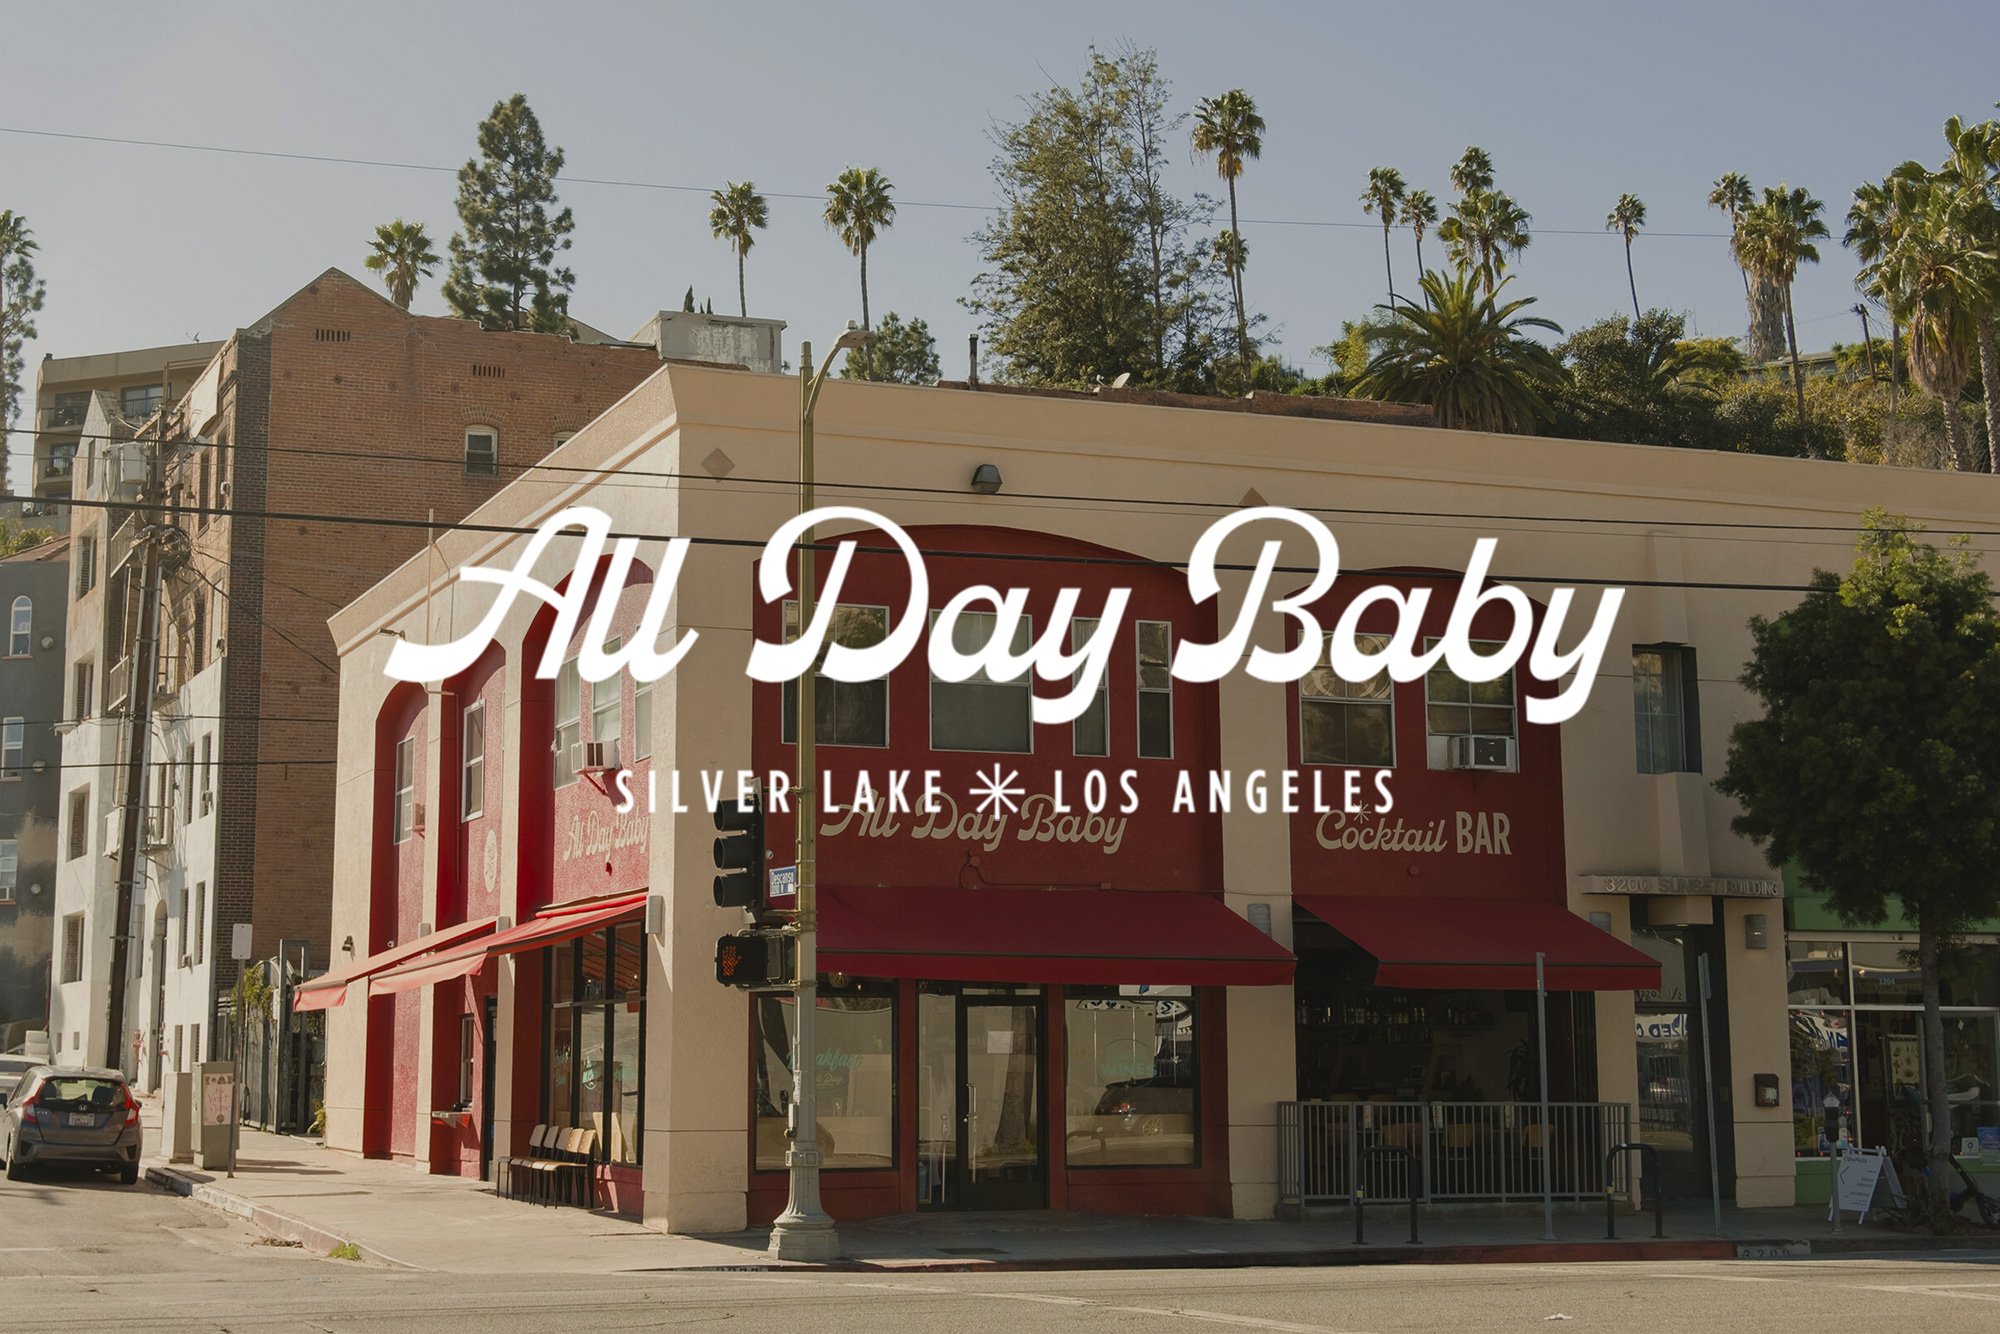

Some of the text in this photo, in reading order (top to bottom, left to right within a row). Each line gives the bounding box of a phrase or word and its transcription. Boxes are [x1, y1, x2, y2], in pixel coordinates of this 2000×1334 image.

[585, 810, 614, 863] Day
[614, 806, 649, 854] Baby
[819, 788, 1128, 855] All Day Baby
[1315, 809, 1512, 855] Cocktail BAR
[1604, 877, 1779, 896] 3200 SUNSET BUILDING
